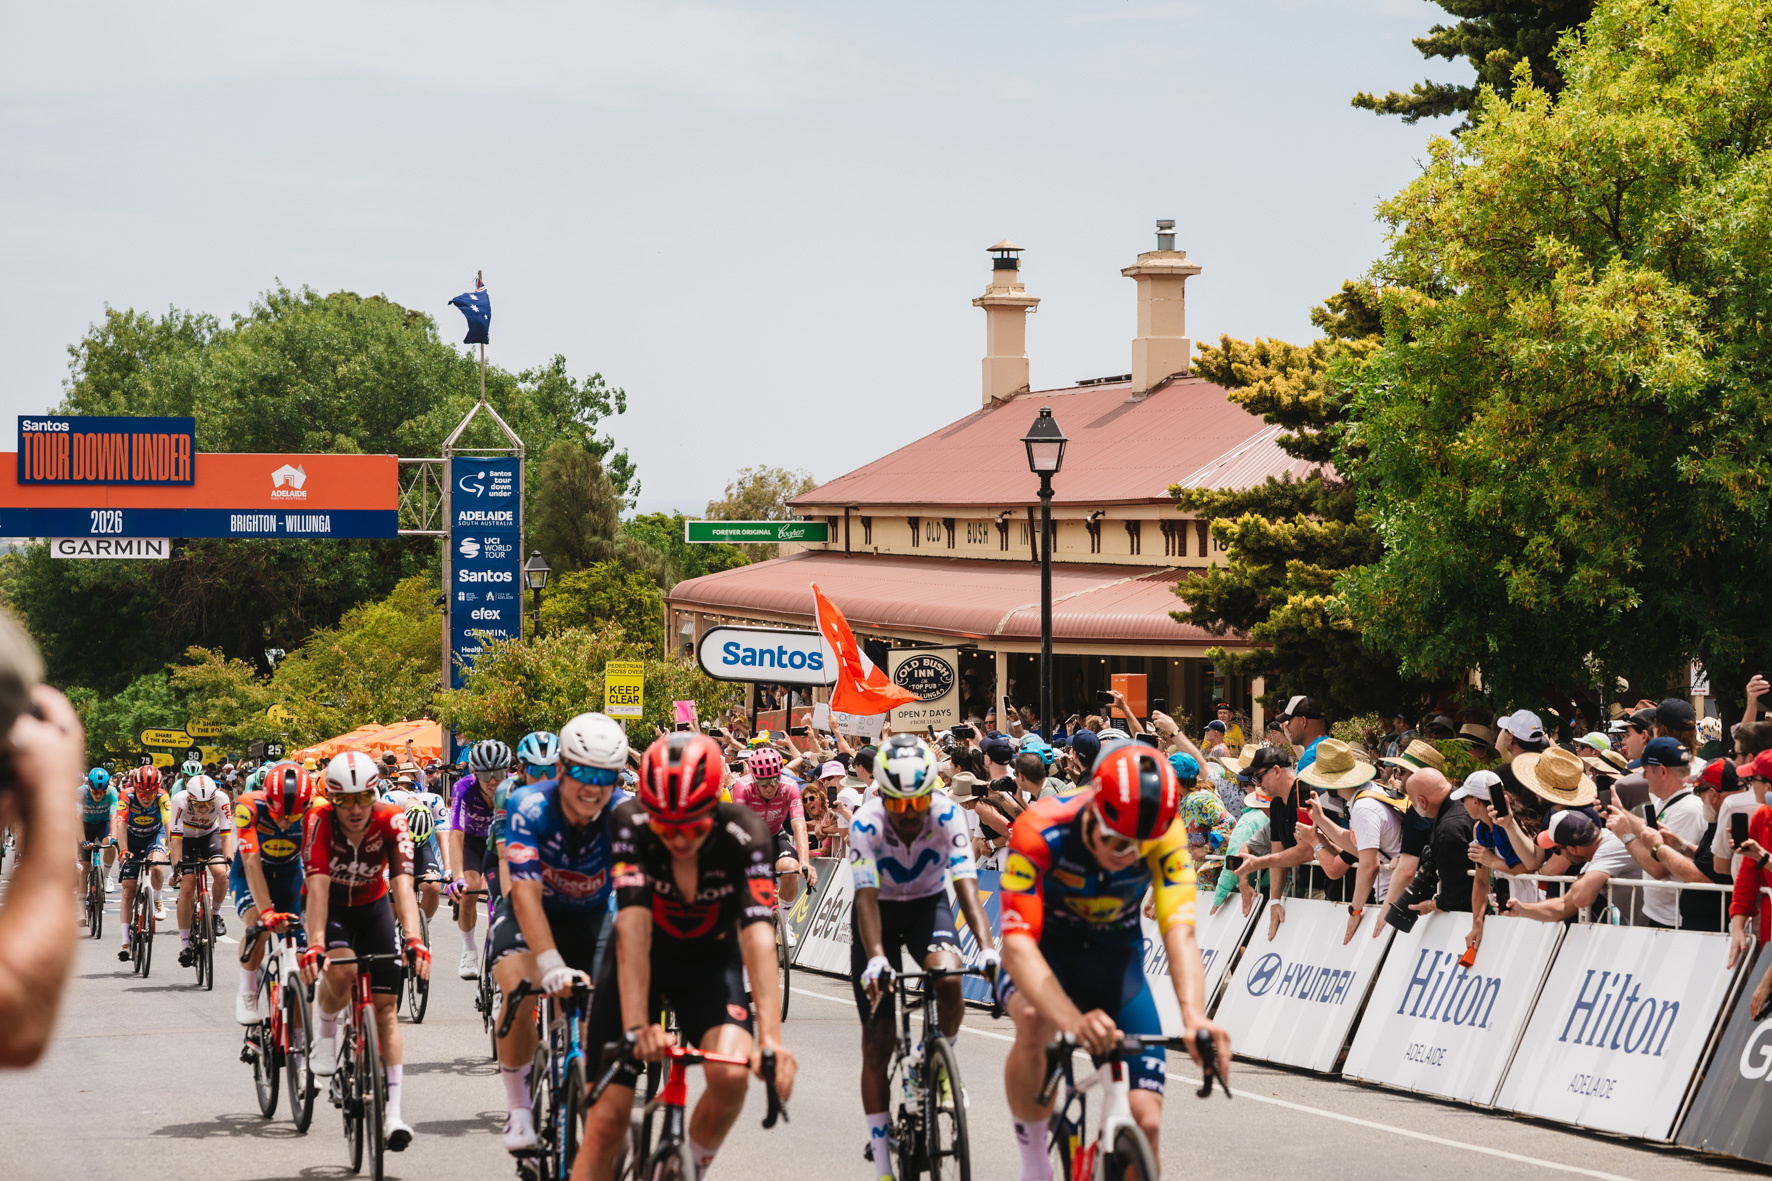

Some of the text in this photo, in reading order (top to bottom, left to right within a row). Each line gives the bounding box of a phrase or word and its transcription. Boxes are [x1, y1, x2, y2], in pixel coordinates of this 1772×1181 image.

[22, 420, 70, 432] Santos
[22, 432, 191, 482] TOUR DOWN UNDER
[91, 510, 123, 534] 2026
[230, 514, 277, 533] BRIGHTON
[285, 514, 331, 533] WILLUNGA
[458, 511, 513, 521] ADELAIDE
[926, 522, 942, 543] OLD
[967, 522, 989, 545] BUSH
[58, 540, 162, 556] GARMIN
[484, 544, 512, 552] WORLD
[459, 569, 512, 583] Santos
[471, 607, 501, 620] efex
[461, 646, 484, 654] Health
[722, 641, 823, 671] Santos
[899, 658, 950, 679] OLD BUSH
[914, 669, 934, 678] INN
[609, 685, 640, 695] KEEP
[609, 695, 640, 705] CLEAR
[898, 708, 952, 719] OPEN 7 DAYS
[188, 751, 199, 760] 50
[268, 744, 282, 756] 25
[328, 855, 383, 878] lotto
[541, 868, 602, 891] Alpecin
[1276, 962, 1357, 1005] HYUNDAI
[1397, 948, 1502, 1029] Hilton
[1558, 969, 1680, 1057] Hilton
[1404, 1042, 1447, 1067] ADELAIDE
[1567, 1073, 1617, 1099] ADELAIDE
